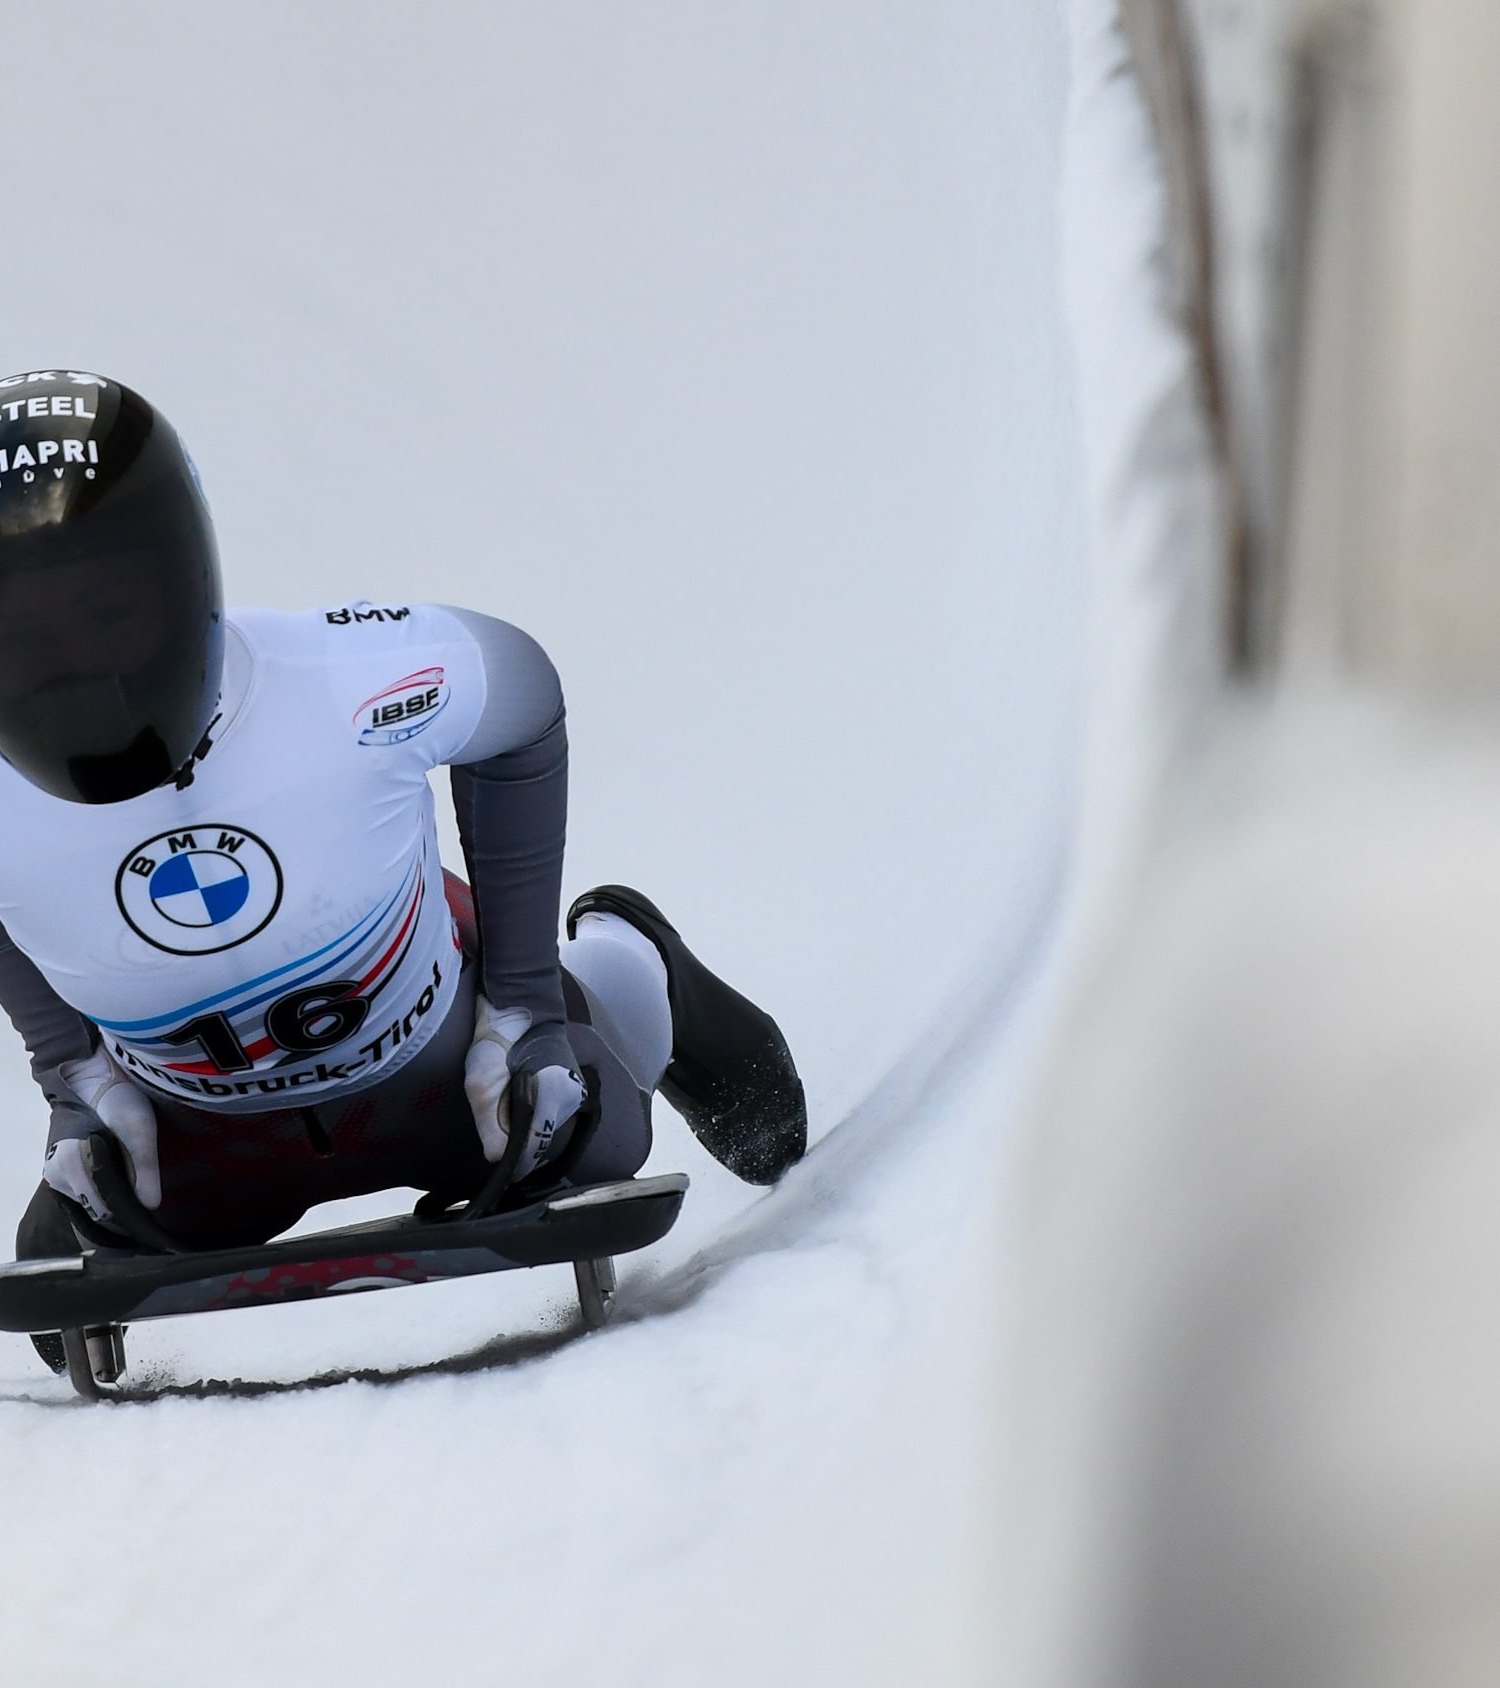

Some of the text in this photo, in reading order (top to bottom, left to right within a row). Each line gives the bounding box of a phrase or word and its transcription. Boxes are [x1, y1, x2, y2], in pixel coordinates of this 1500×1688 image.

[325, 607, 410, 625] BMW
[372, 687, 440, 723] IBSF
[129, 831, 246, 877] BMW
[160, 980, 372, 1073] 16
